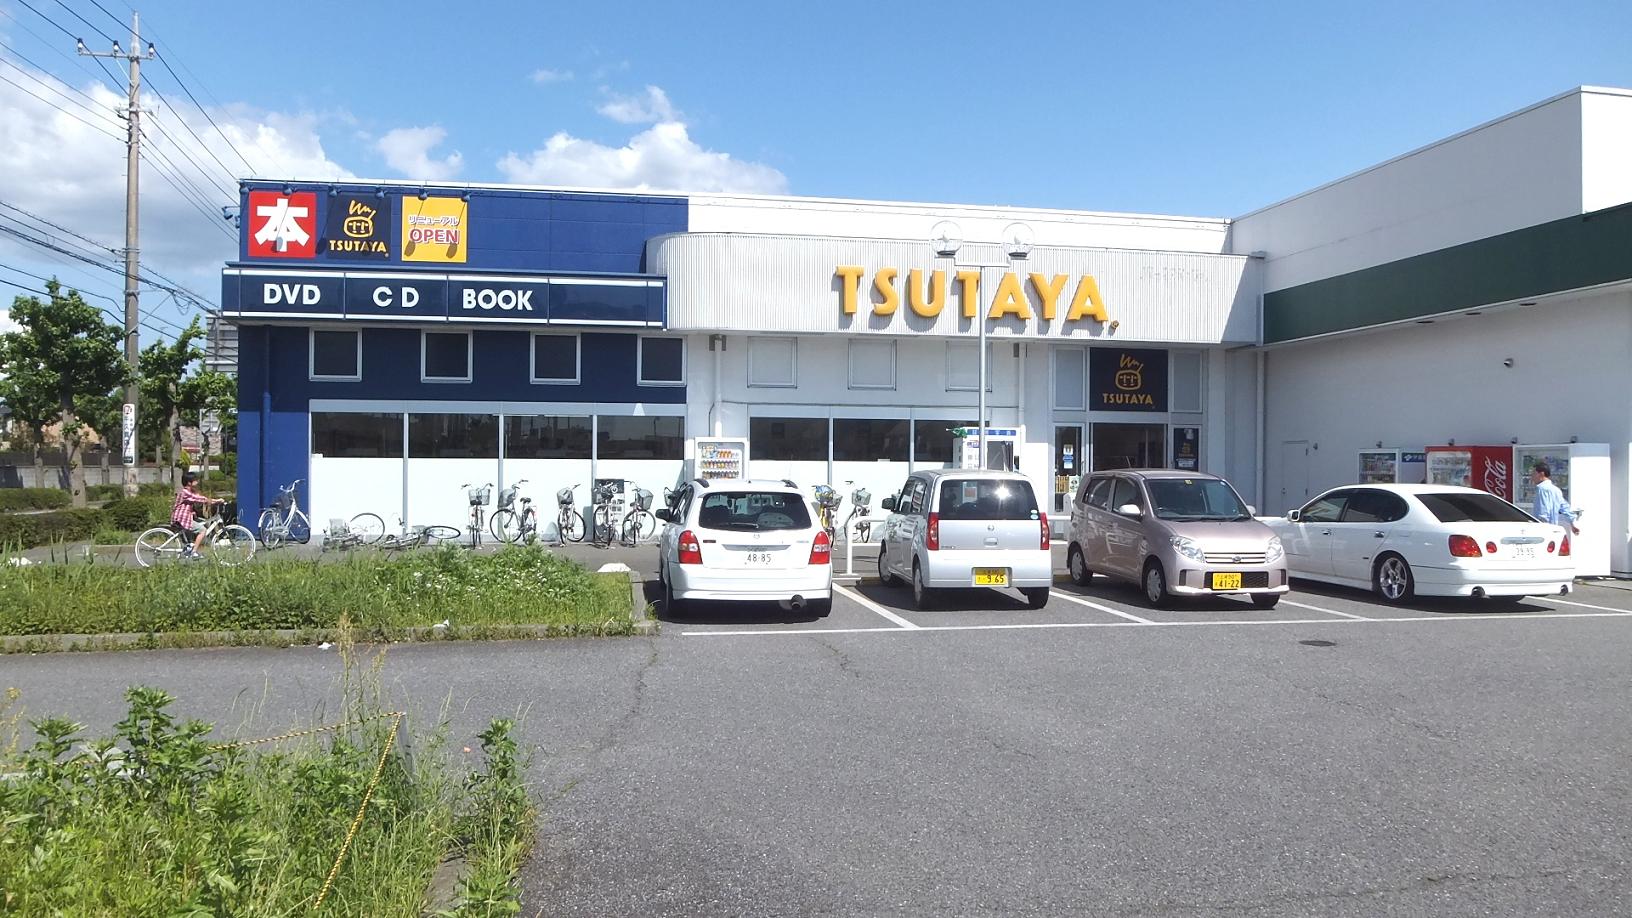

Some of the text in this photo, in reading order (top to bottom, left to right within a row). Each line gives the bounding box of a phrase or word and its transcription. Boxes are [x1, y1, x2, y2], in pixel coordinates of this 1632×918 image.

[254, 197, 310, 252] 本
[409, 215, 459, 227] リニューアル
[410, 229, 459, 244] OPEN
[329, 240, 387, 253] TSUTAYA
[263, 283, 321, 305] DVD
[462, 288, 533, 311] BOOK
[836, 266, 1109, 322] TSUTAYA
[1102, 393, 1153, 405] TSUTAYA
